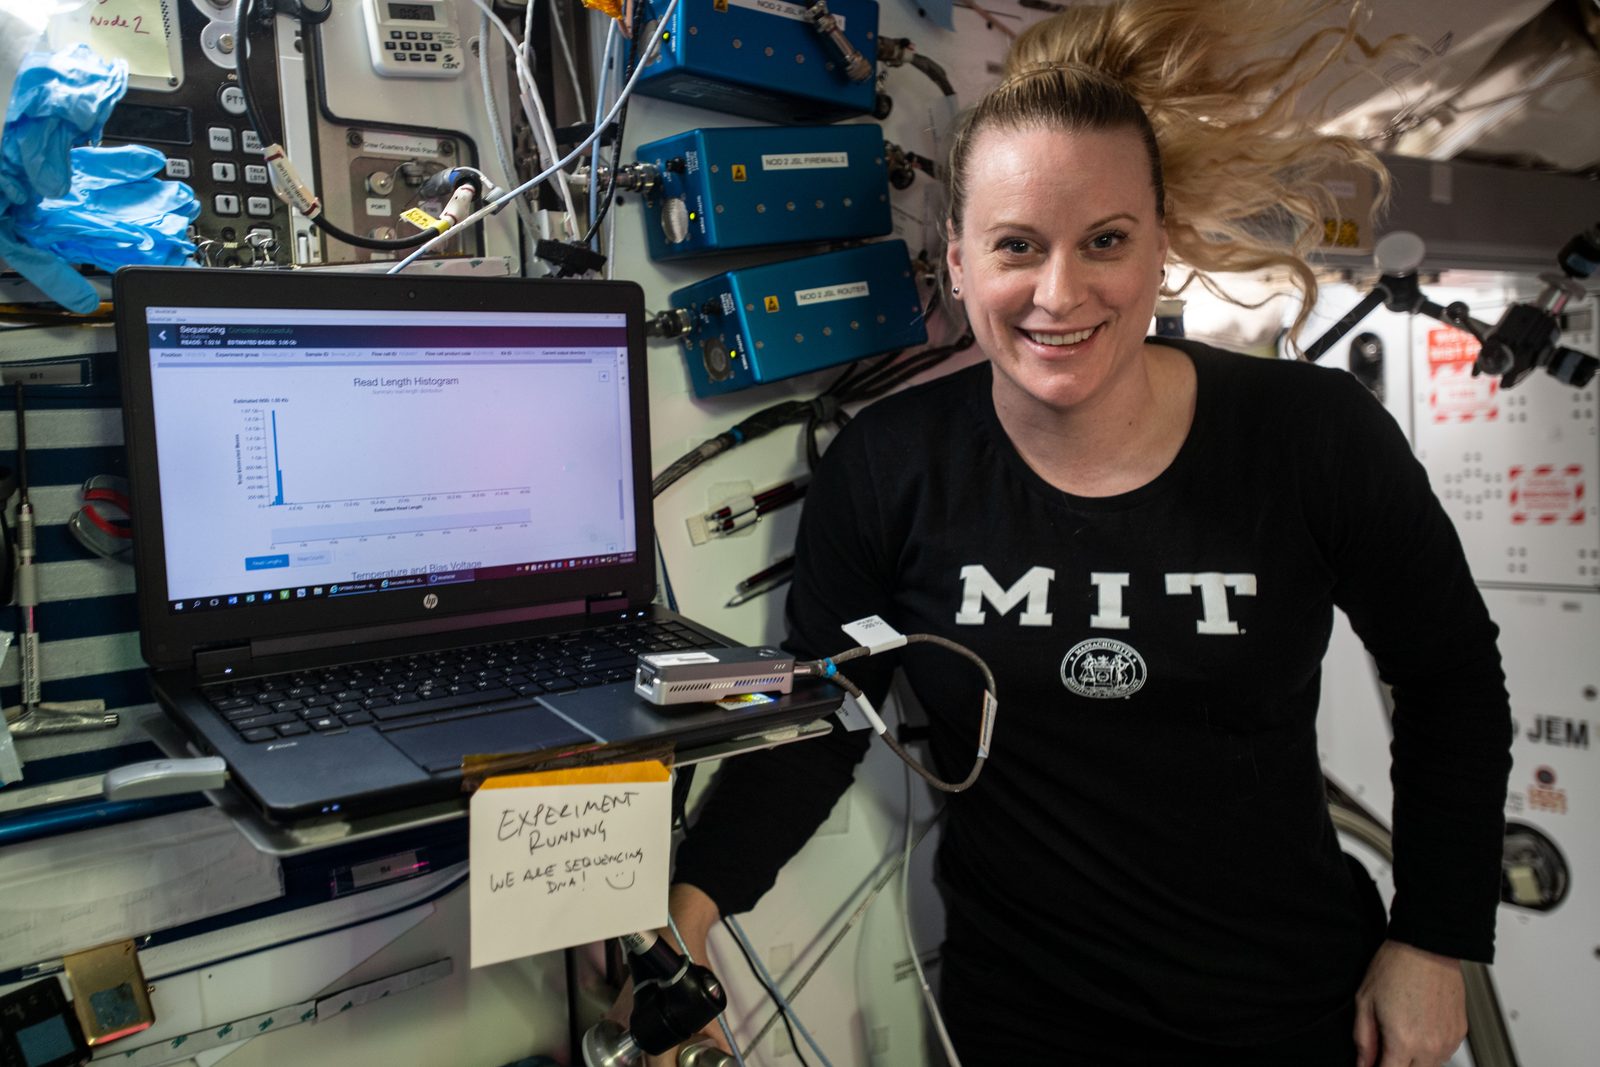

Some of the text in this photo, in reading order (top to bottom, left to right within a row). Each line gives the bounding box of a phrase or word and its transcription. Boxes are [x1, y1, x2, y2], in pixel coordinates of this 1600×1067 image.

[89, 14, 150, 35] Node 2
[765, 157, 783, 166] NOD
[784, 157, 789, 165] 2
[790, 157, 803, 165] JSL
[804, 155, 840, 164] FIREWALL
[799, 285, 867, 301] NOD 2 JSL ROUTER
[179, 325, 226, 337] Sequencing
[353, 376, 459, 389] Read Length Histogram
[352, 559, 482, 581] Temperature and Bias Voltage
[425, 594, 437, 609] hp
[955, 564, 1257, 635] MIT
[1526, 714, 1590, 750] JEM
[497, 791, 639, 842] EXPERIMENT
[490, 847, 644, 893] WE ARE SEQUENCING
[546, 871, 587, 894] DNA!
